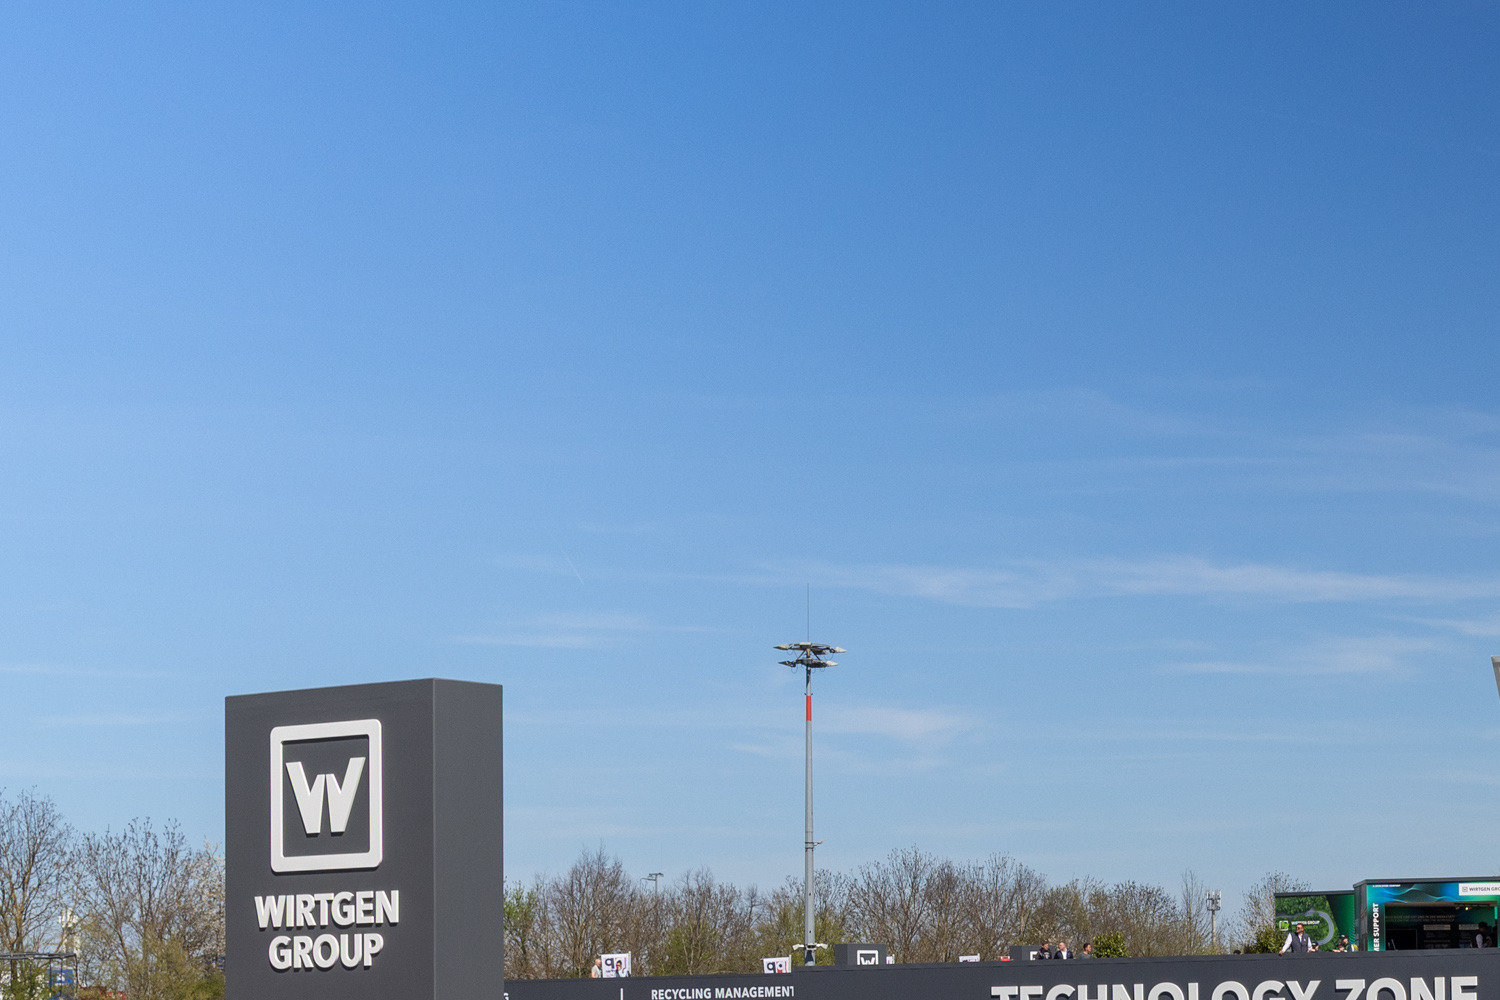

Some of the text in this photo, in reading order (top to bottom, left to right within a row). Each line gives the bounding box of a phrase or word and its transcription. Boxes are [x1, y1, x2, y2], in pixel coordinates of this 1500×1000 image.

[254, 889, 400, 929] WIRTGEN
[1372, 902, 1380, 938] SUPPORT
[268, 933, 384, 970] GROUP
[651, 987, 712, 1000] RECYCLING
